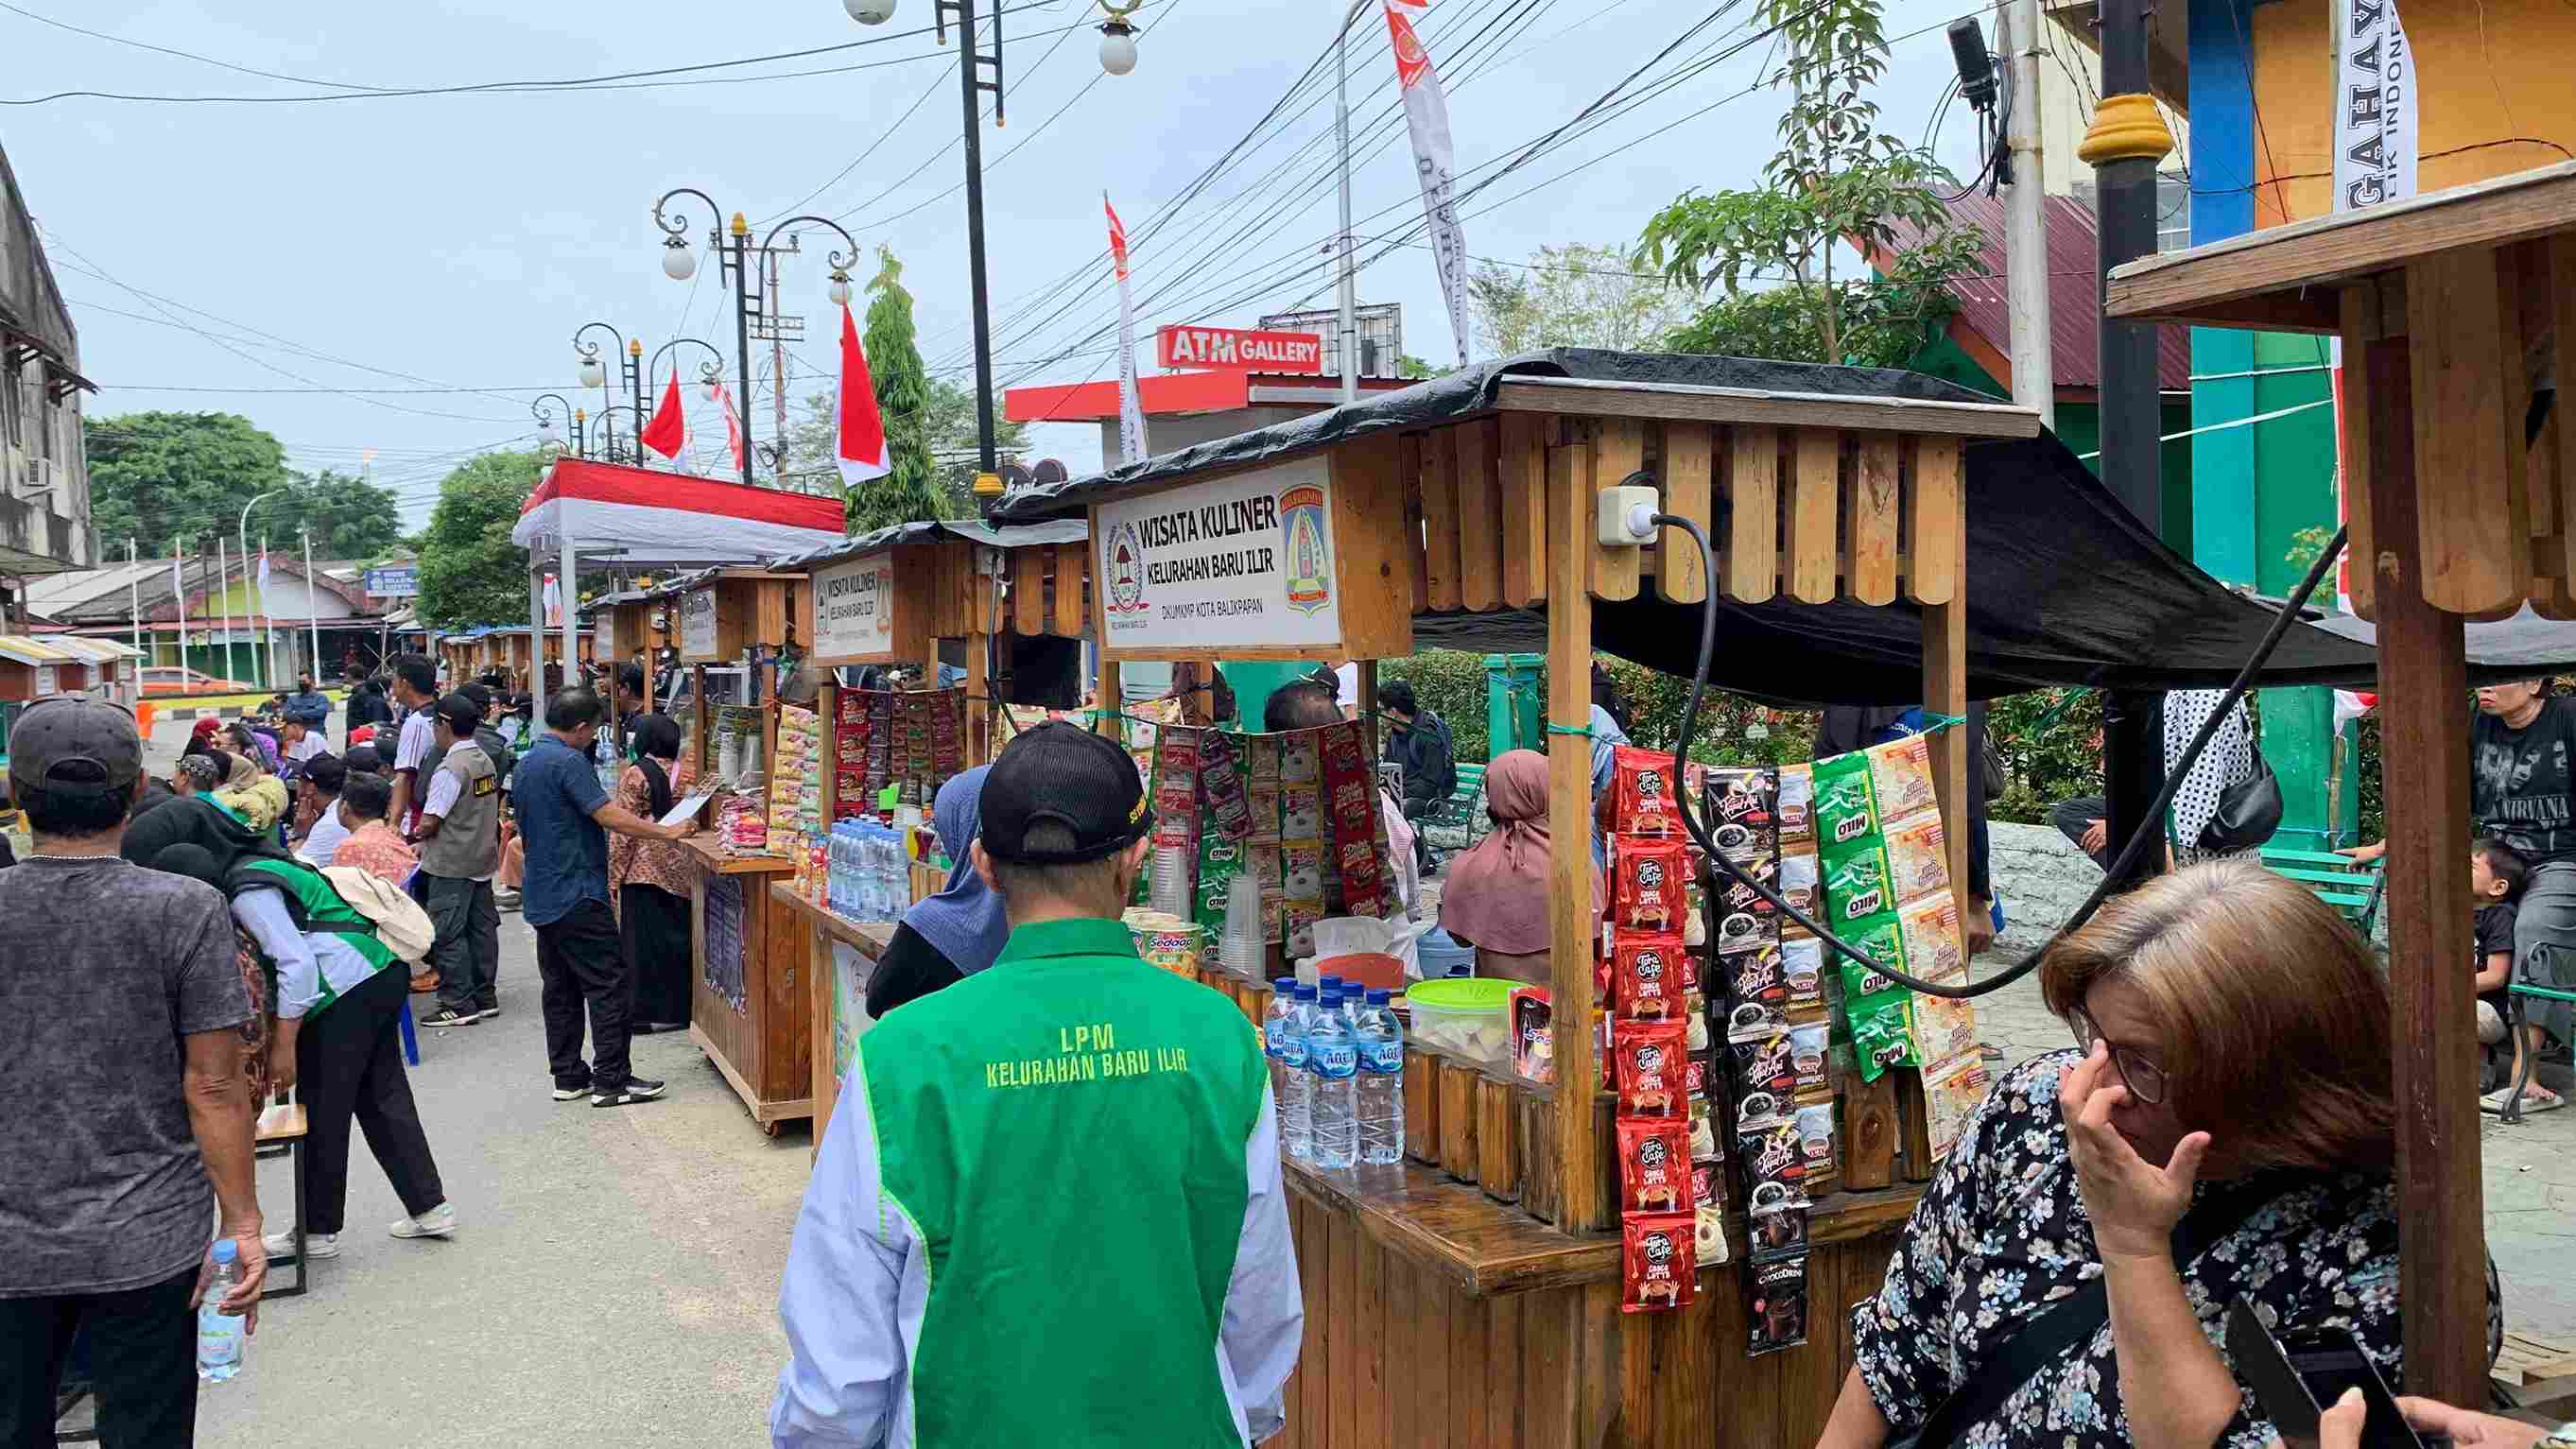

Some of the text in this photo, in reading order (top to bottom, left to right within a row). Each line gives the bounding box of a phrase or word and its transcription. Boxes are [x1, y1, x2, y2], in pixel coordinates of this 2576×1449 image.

[1172, 331, 1319, 364] ATM GALLERY
[1139, 508, 1199, 549] WISATA
[1202, 494, 1279, 539] KULINER
[1147, 547, 1275, 585] KELURAHAN BARU ILIR
[1196, 601, 1216, 617] KOTA
[1217, 597, 1264, 616] BALIKPAPAN
[2501, 796, 2570, 820] NIRVANA
[1838, 815, 1866, 836] MILO
[1639, 863, 1660, 874] Tora
[1639, 871, 1663, 884] Cafe
[1850, 892, 1879, 912] MILO
[1638, 955, 1659, 966] Tora
[1638, 964, 1661, 977] Cafe
[1060, 1023, 1115, 1053] LPM
[1326, 1051, 1355, 1064] AQUA
[1378, 1046, 1400, 1060] AQU
[1637, 1046, 1659, 1059] Tora
[1874, 1045, 1903, 1062] MILO
[986, 1046, 1188, 1088] KELURAHAN BARU ILIR
[1640, 1141, 1663, 1153] Tora
[1641, 1150, 1666, 1164] Cafe
[1644, 1234, 1668, 1248] Tora
[1646, 1246, 1672, 1259] Cafe
